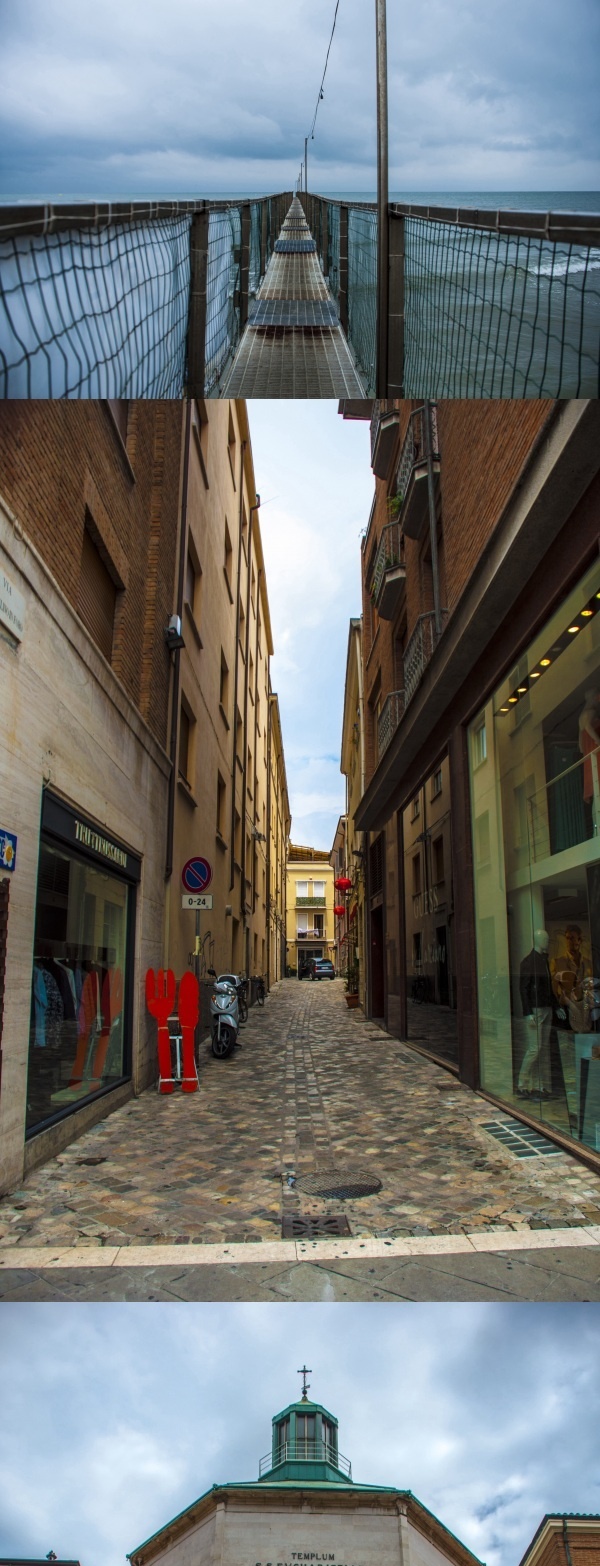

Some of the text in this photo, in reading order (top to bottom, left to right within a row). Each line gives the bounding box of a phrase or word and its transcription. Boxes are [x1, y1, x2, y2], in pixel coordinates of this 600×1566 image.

[188, 897, 206, 906] 0-24
[414, 887, 439, 918] GUESS
[291, 1552, 335, 1561] TEMPLUM
